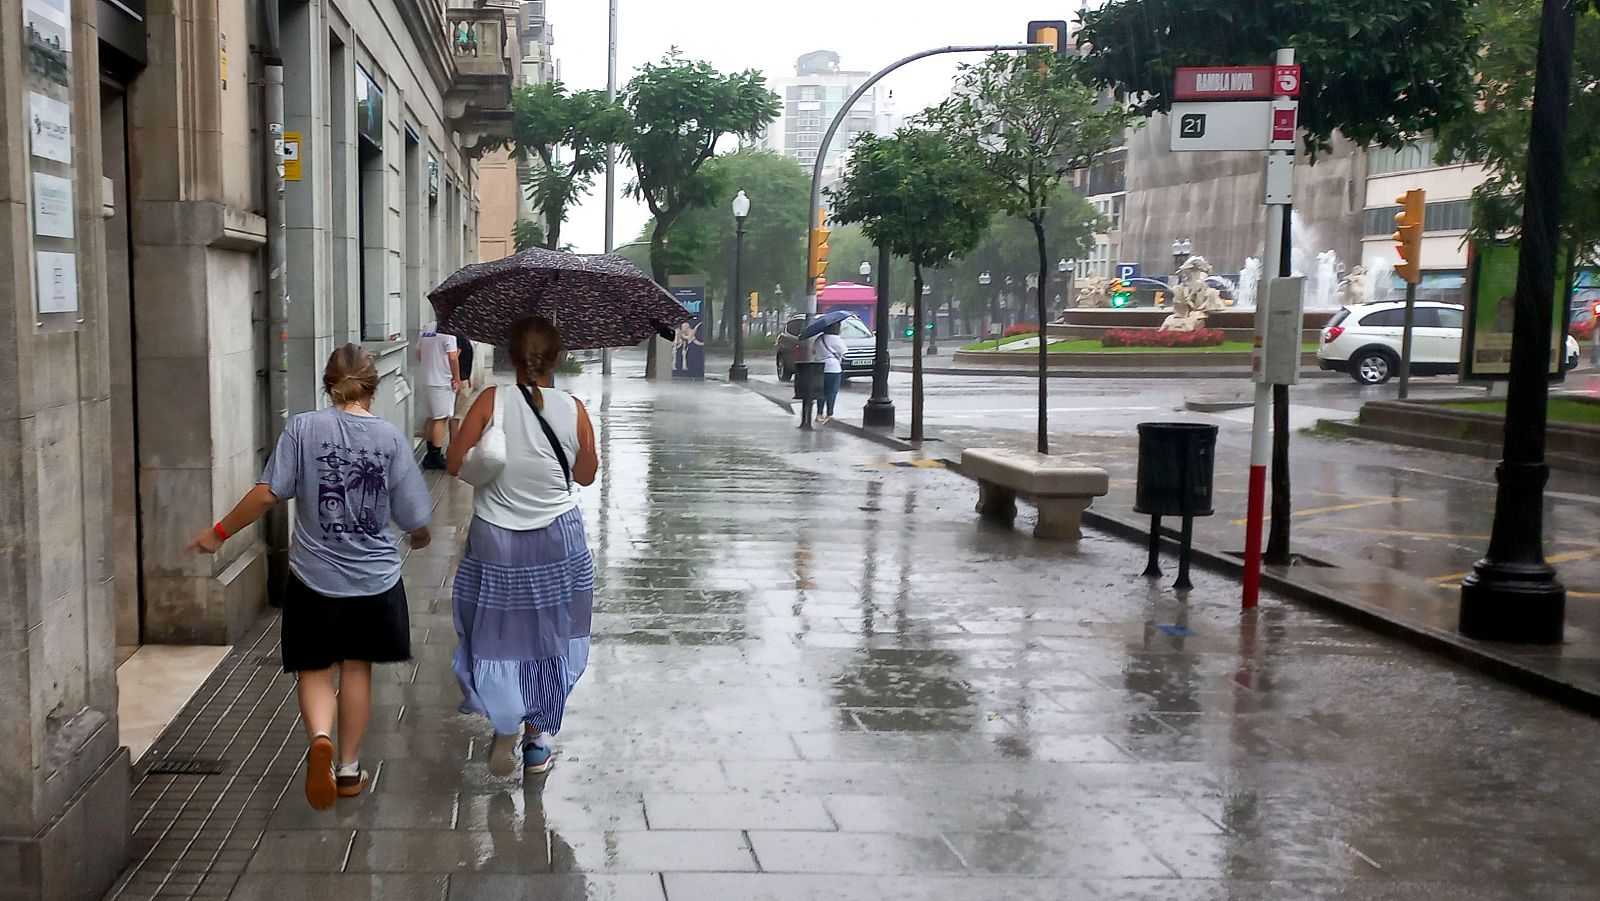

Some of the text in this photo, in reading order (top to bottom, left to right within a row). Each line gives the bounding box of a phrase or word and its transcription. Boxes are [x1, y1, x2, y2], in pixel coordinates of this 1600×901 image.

[1196, 73, 1253, 91] RAMBLA NOVA
[1184, 119, 1202, 133] 21
[1121, 266, 1134, 280] P
